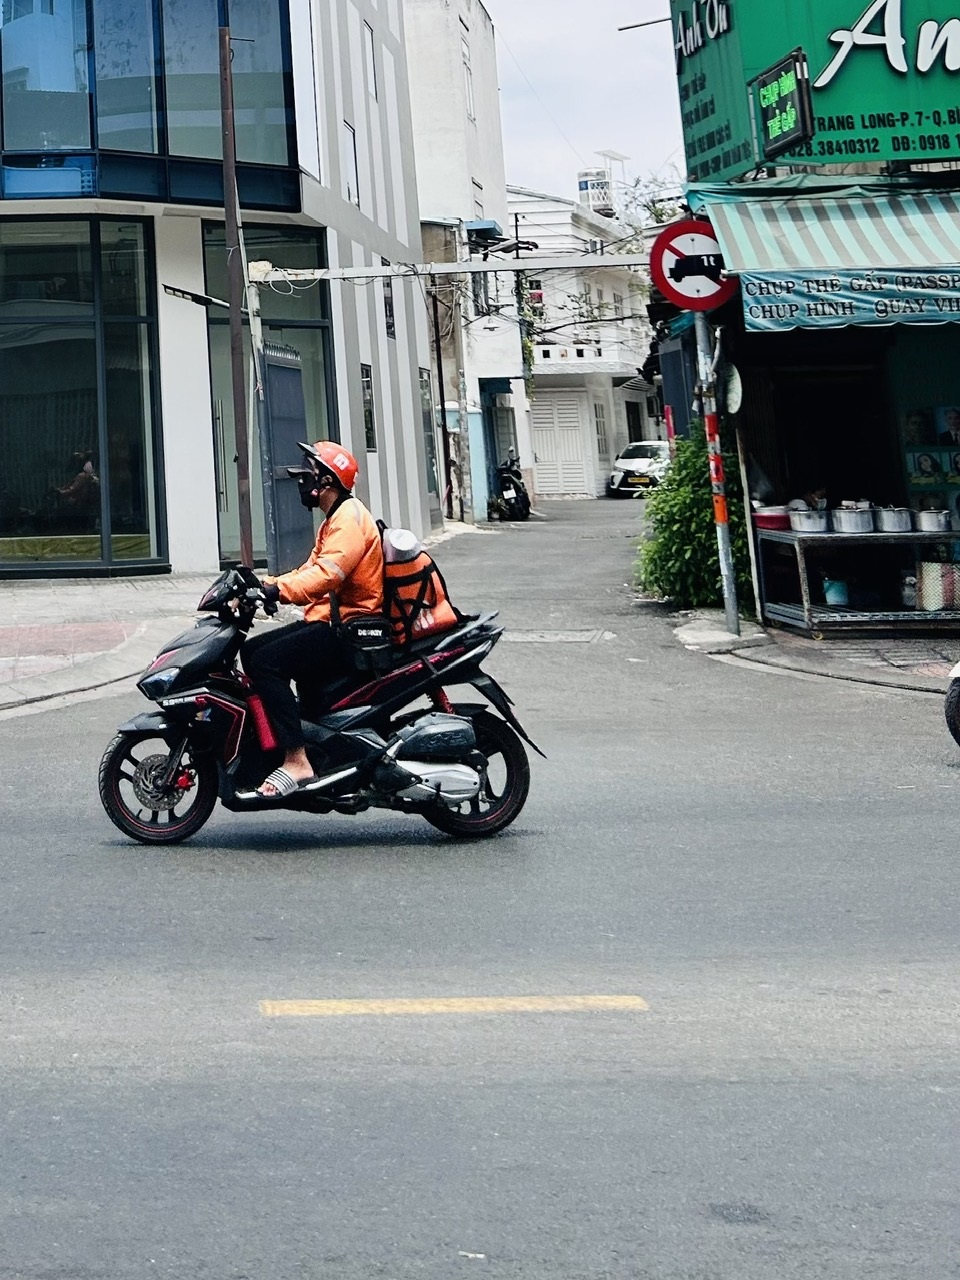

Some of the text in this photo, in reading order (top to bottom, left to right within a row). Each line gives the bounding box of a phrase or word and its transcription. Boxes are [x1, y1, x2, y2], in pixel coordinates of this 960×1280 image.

[674, 0, 703, 60] Anh
[700, 255, 716, 266] 1t
[745, 280, 795, 299] CHỤP
[802, 272, 841, 294] THẺ
[850, 270, 889, 292] GẤP
[748, 303, 799, 322] CHỤP
[806, 297, 855, 317] HÌNH
[874, 297, 927, 319] QUAY
